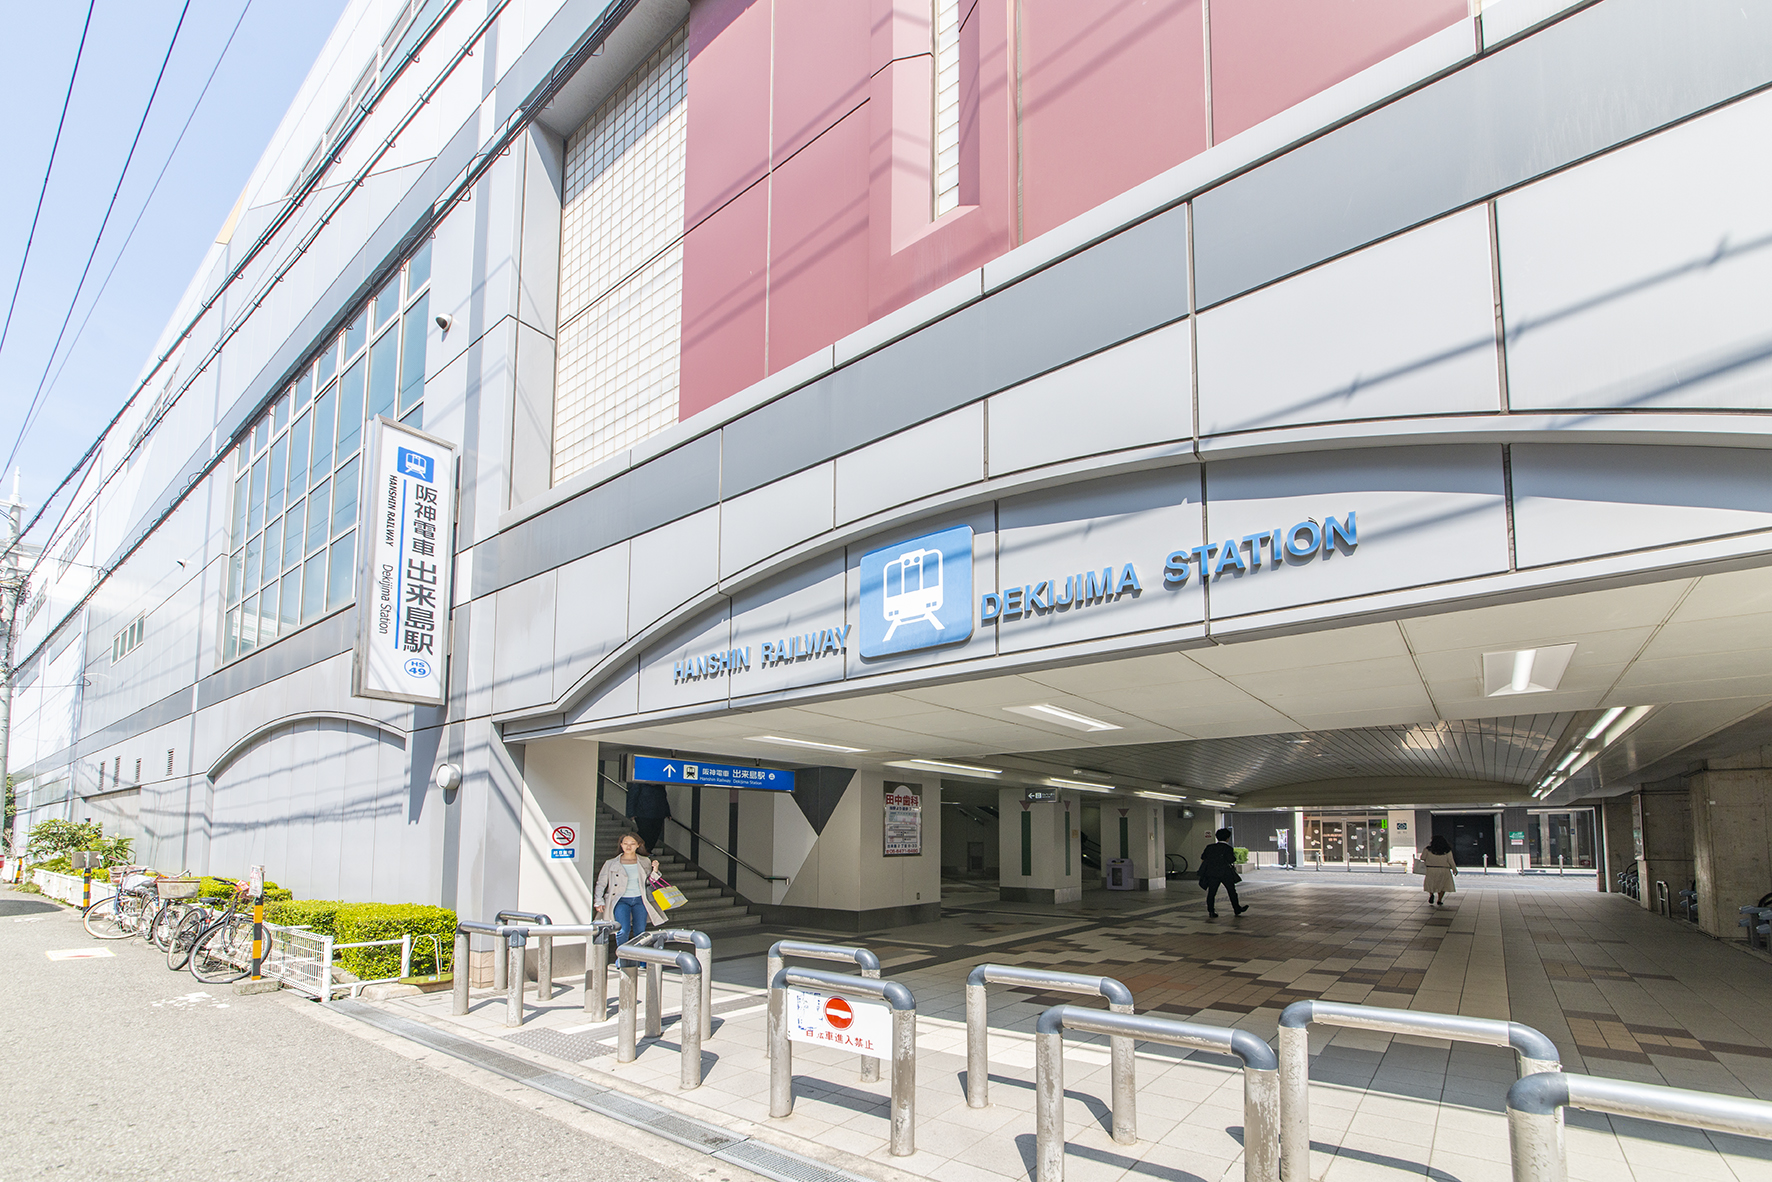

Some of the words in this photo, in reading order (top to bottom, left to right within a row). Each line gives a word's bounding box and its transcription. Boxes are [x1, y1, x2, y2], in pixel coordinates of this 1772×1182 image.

[387, 474, 398, 511] HANSHIN
[385, 511, 396, 547] RAILWAY
[412, 484, 438, 557] 阪神電車
[379, 564, 394, 602] Dekijima
[981, 562, 1143, 622] DEKIJIMA
[1164, 511, 1359, 584] STATION
[379, 603, 392, 635] Station
[403, 558, 437, 656] 出来島駅
[409, 667, 426, 675] 49
[673, 646, 751, 681] HANSHIN
[761, 624, 852, 666] RAILWAY
[732, 769, 766, 780] 出来島駅
[886, 794, 919, 806] 田中歯科
